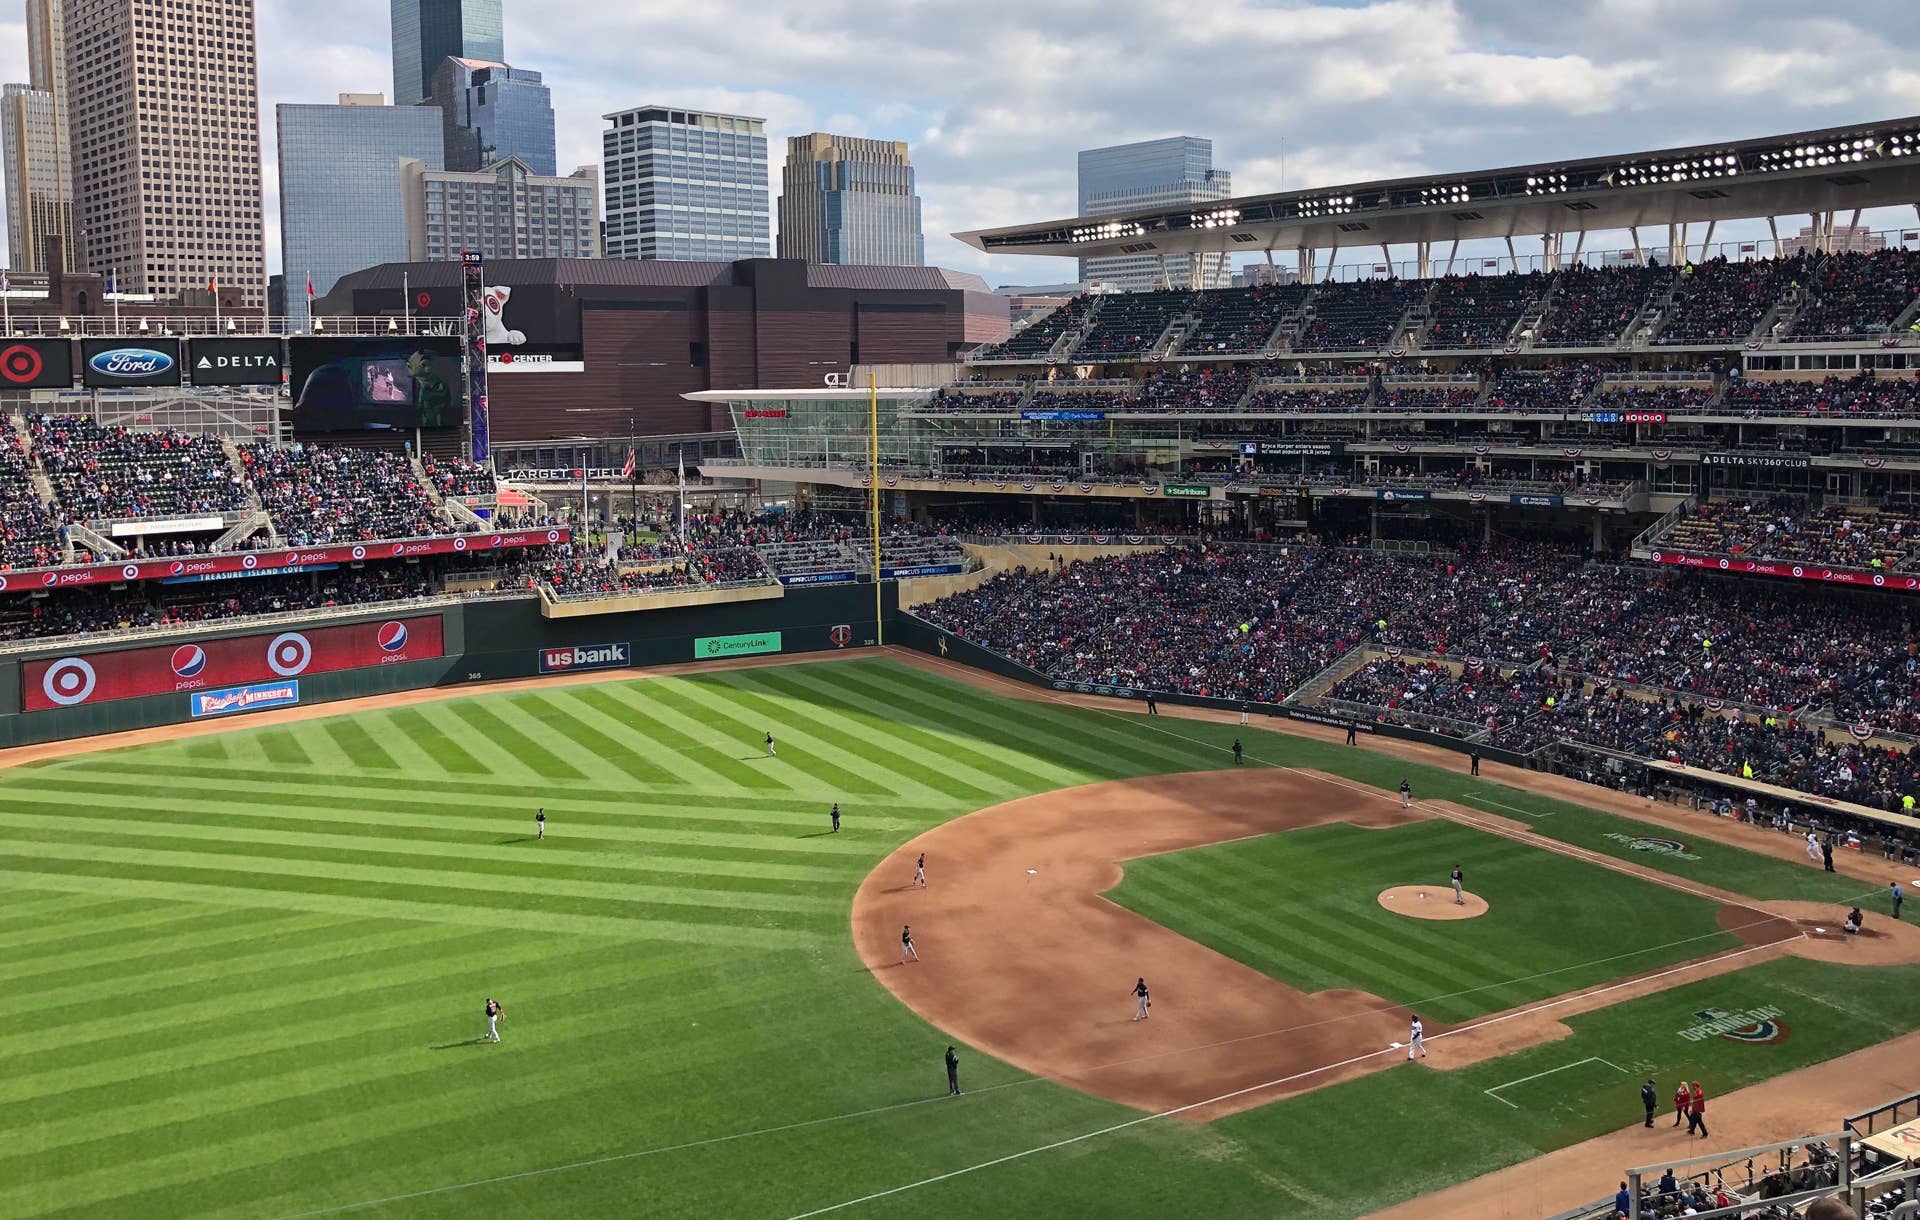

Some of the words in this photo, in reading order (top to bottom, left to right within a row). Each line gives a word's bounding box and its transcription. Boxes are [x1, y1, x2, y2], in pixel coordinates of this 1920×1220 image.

[107, 353, 156, 372] Ford
[217, 355, 276, 368] DELTA
[513, 354, 553, 363] CENTER
[1713, 456, 1744, 465] DELTA
[508, 469, 568, 479] TARGET
[503, 534, 526, 546] pepsi
[406, 542, 431, 554] pepsi
[300, 551, 327, 564] pepsi
[1686, 556, 1704, 565] pepsi
[186, 561, 215, 573] pepsi
[1756, 564, 1776, 574] pepsi
[61, 571, 92, 584] pepsi
[200, 571, 242, 581] TREASURE
[248, 568, 278, 577] ISLAND
[282, 566, 303, 575] COVE
[1833, 572, 1855, 582] pepsi
[723, 639, 767, 650] CenturyLink
[381, 653, 407, 664] pepsi
[468, 672, 481, 680] 365
[175, 679, 204, 691] pepsi
[1676, 1013, 1758, 1042] OPENING
[1745, 1004, 1786, 1021] DAY
